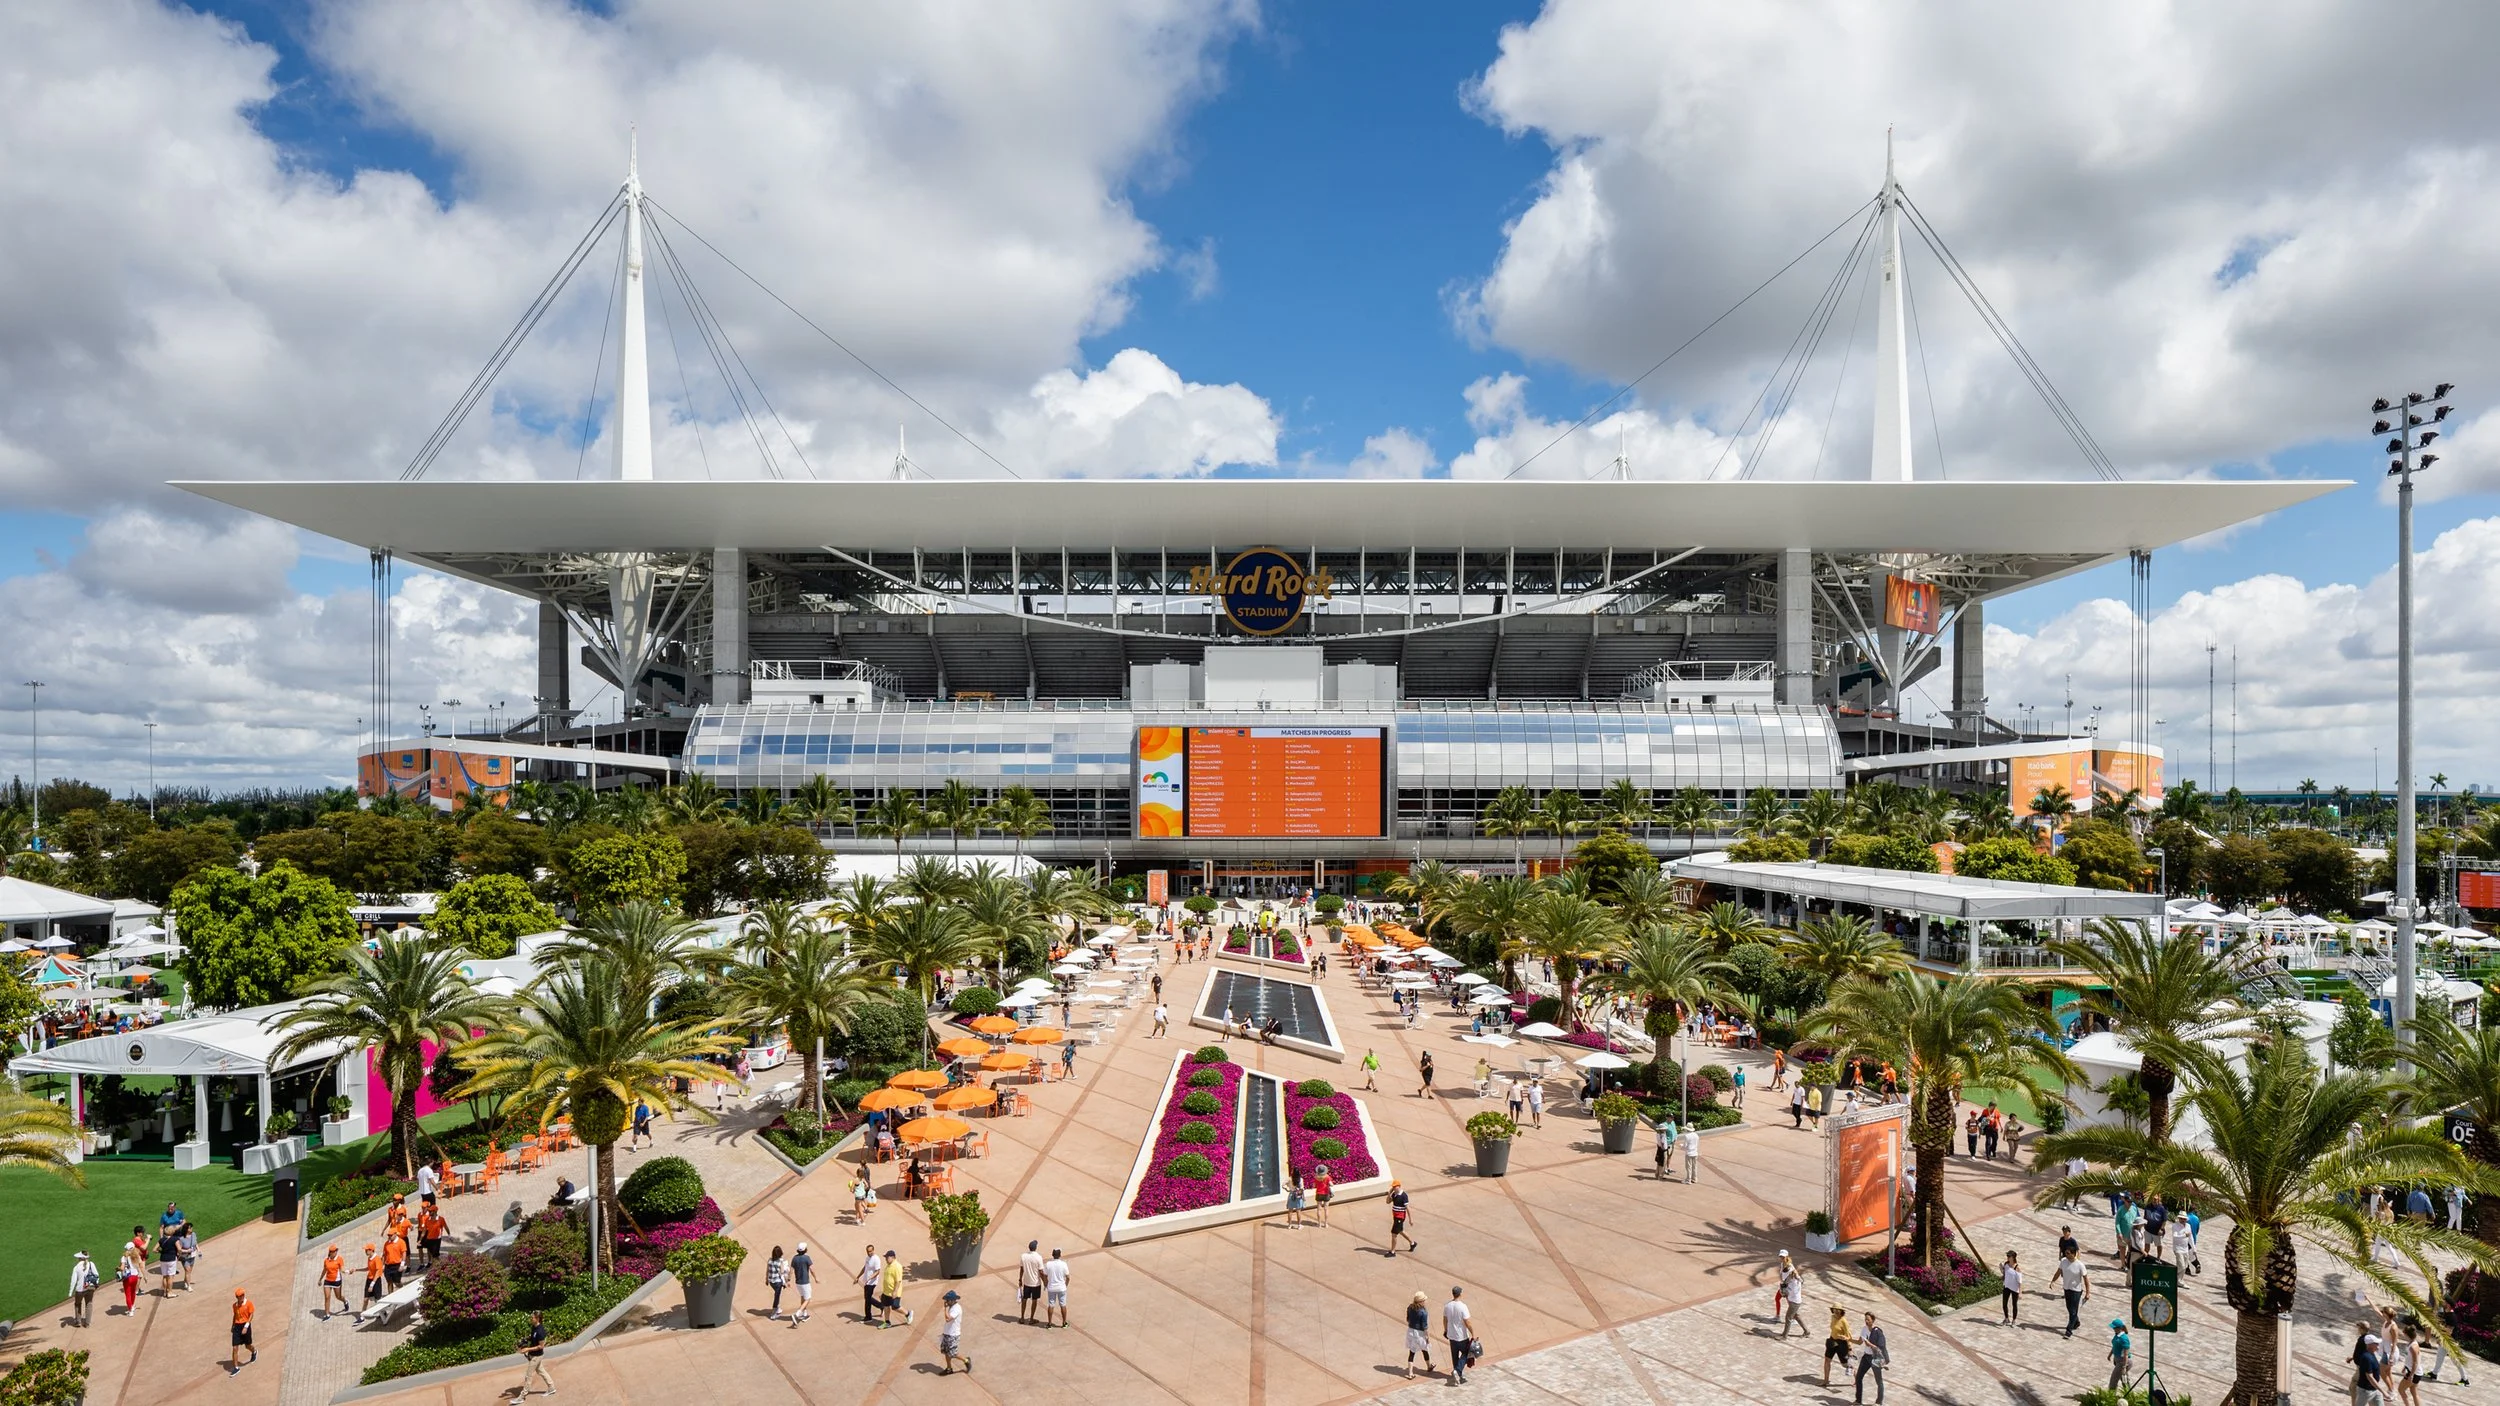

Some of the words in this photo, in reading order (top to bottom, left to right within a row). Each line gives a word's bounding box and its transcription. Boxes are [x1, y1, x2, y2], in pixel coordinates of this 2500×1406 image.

[1189, 565, 1261, 595] Hard
[1265, 565, 1335, 601] Rock
[1237, 607, 1288, 617] STADIUM
[1672, 885, 1693, 905] KIKI
[2455, 1119, 2473, 1128] Court
[2140, 1278, 2170, 1288] ROLEX
